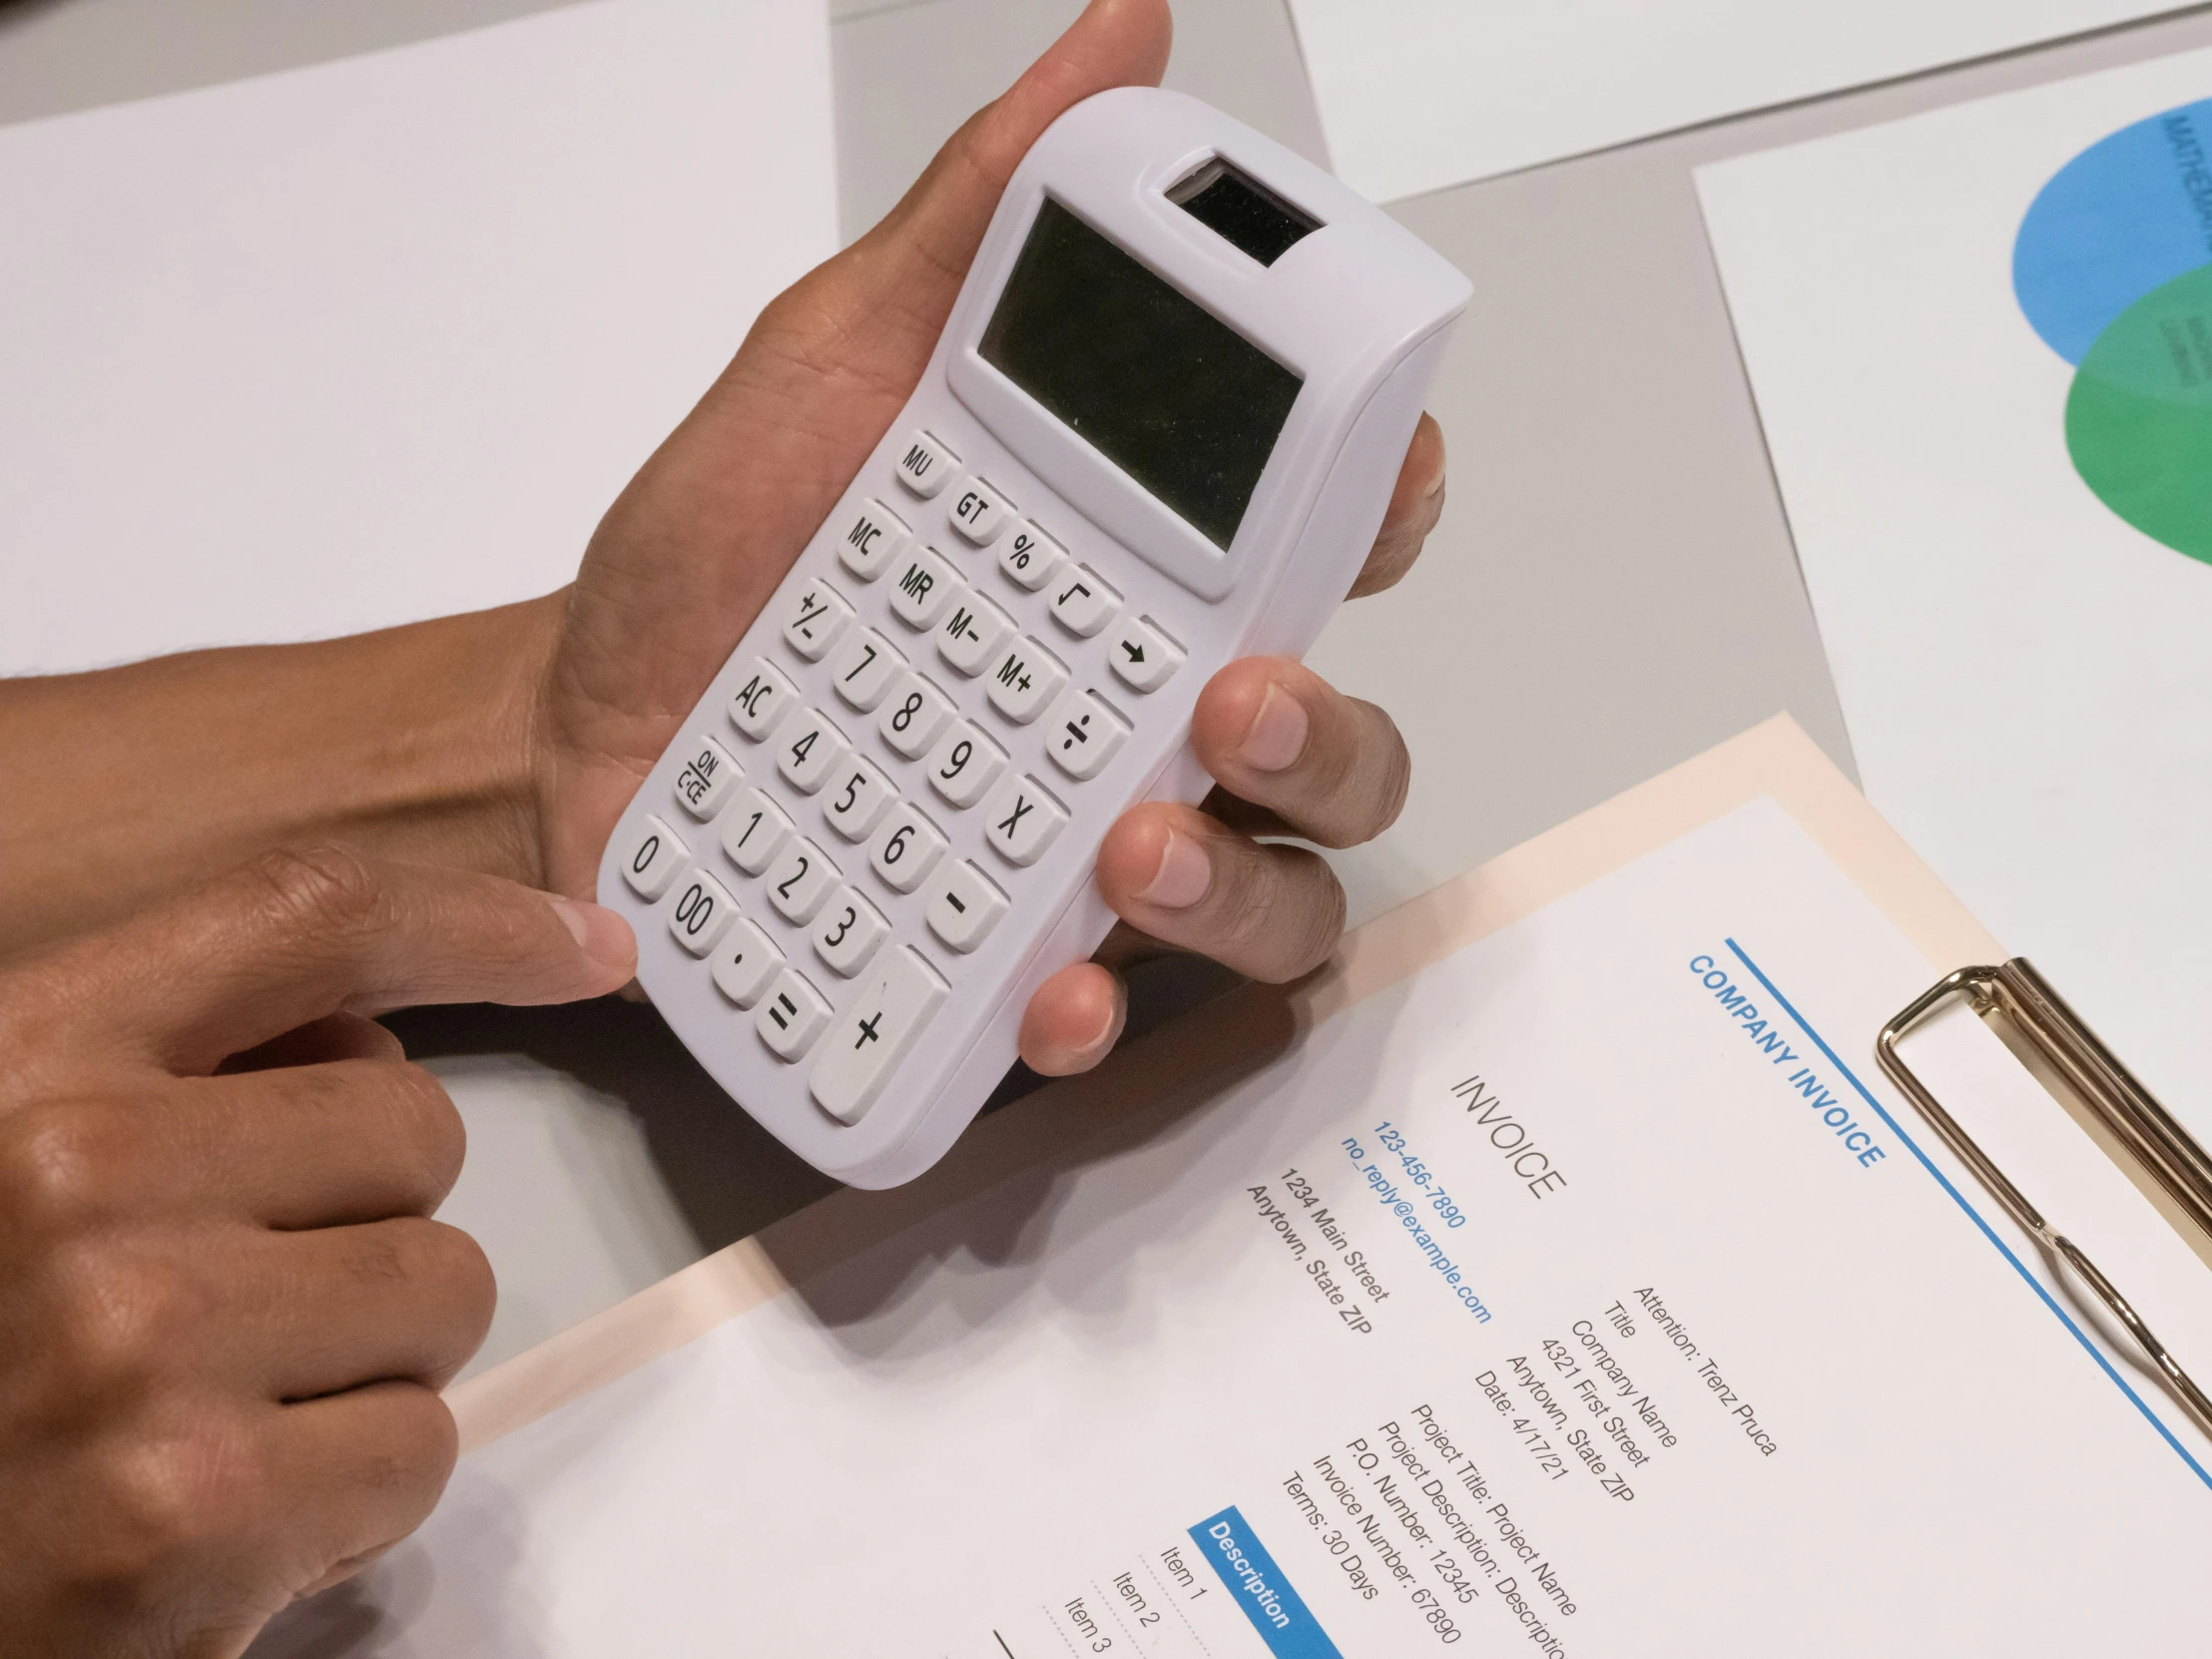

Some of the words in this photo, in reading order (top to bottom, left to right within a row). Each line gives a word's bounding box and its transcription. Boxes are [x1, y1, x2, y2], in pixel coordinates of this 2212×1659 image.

[901, 444, 933, 476] MU
[956, 492, 990, 524] GT
[846, 515, 882, 556] MC
[897, 562, 934, 603] MR
[843, 643, 876, 683] 7
[995, 653, 1032, 692] M+
[734, 675, 773, 718] AC
[891, 692, 922, 731] 8
[698, 751, 719, 778] ON
[791, 730, 820, 767] 4
[939, 740, 972, 779] 9
[834, 772, 866, 813] 5
[632, 834, 659, 873] 0
[737, 812, 763, 848] 1
[883, 825, 915, 864] 6
[776, 855, 809, 900] 2
[675, 883, 715, 935] 00
[824, 906, 856, 946] 3
[1690, 955, 1800, 1065] COMPANY
[1788, 1068, 1887, 1168] INVOICE
[1450, 1075, 1567, 1200] INVOICE
[1375, 1121, 1465, 1228] 123-456-7890
[1282, 1168, 1320, 1208] 1234
[1311, 1208, 1348, 1251] Main
[1344, 1251, 1389, 1303] Street
[1342, 1138, 1491, 1324] no_reply@example.com
[1247, 1186, 1307, 1261] Anytown,
[1306, 1260, 1344, 1305] State
[1339, 1305, 1372, 1334] ZIP
[1605, 1301, 1635, 1338] Title
[1572, 1321, 1639, 1396] Company
[1632, 1396, 1677, 1447] Name
[1633, 1288, 1700, 1361] Attention:
[1698, 1358, 1738, 1406] Trenz
[1732, 1404, 1777, 1456] Pruca
[1475, 1371, 1515, 1416] Date:
[1513, 1419, 1569, 1479] 4/17/21
[1506, 1357, 1567, 1430] Anytown,
[1567, 1429, 1606, 1474] State
[1600, 1472, 1634, 1501] ZIP
[1542, 1341, 1581, 1379] 4321
[1573, 1380, 1610, 1417] First
[1603, 1416, 1650, 1468] Street
[1347, 1438, 1379, 1476] P.O.
[1374, 1474, 1433, 1548] Number:
[1430, 1549, 1479, 1603] 12345
[1379, 1421, 1430, 1481] Project
[1421, 1479, 1500, 1578] Description:
[1410, 1404, 1463, 1463] Project
[1457, 1460, 1491, 1504] Title:
[1486, 1503, 1540, 1564] Project
[1531, 1562, 1576, 1616] Name
[1283, 1470, 1328, 1530] Terms:
[1323, 1530, 1350, 1555] 30
[1341, 1554, 1379, 1600] Days
[1314, 1455, 1362, 1515] Invoice
[1357, 1514, 1416, 1588] Number:
[1411, 1589, 1461, 1643] 67890
[1113, 1572, 1146, 1612] Item
[1139, 1612, 1160, 1628] 2
[1161, 1546, 1194, 1587] Item
[1191, 1588, 1208, 1600] 1
[1208, 1520, 1290, 1629] Description
[1065, 1597, 1098, 1638] Item
[1092, 1638, 1112, 1652] 3
